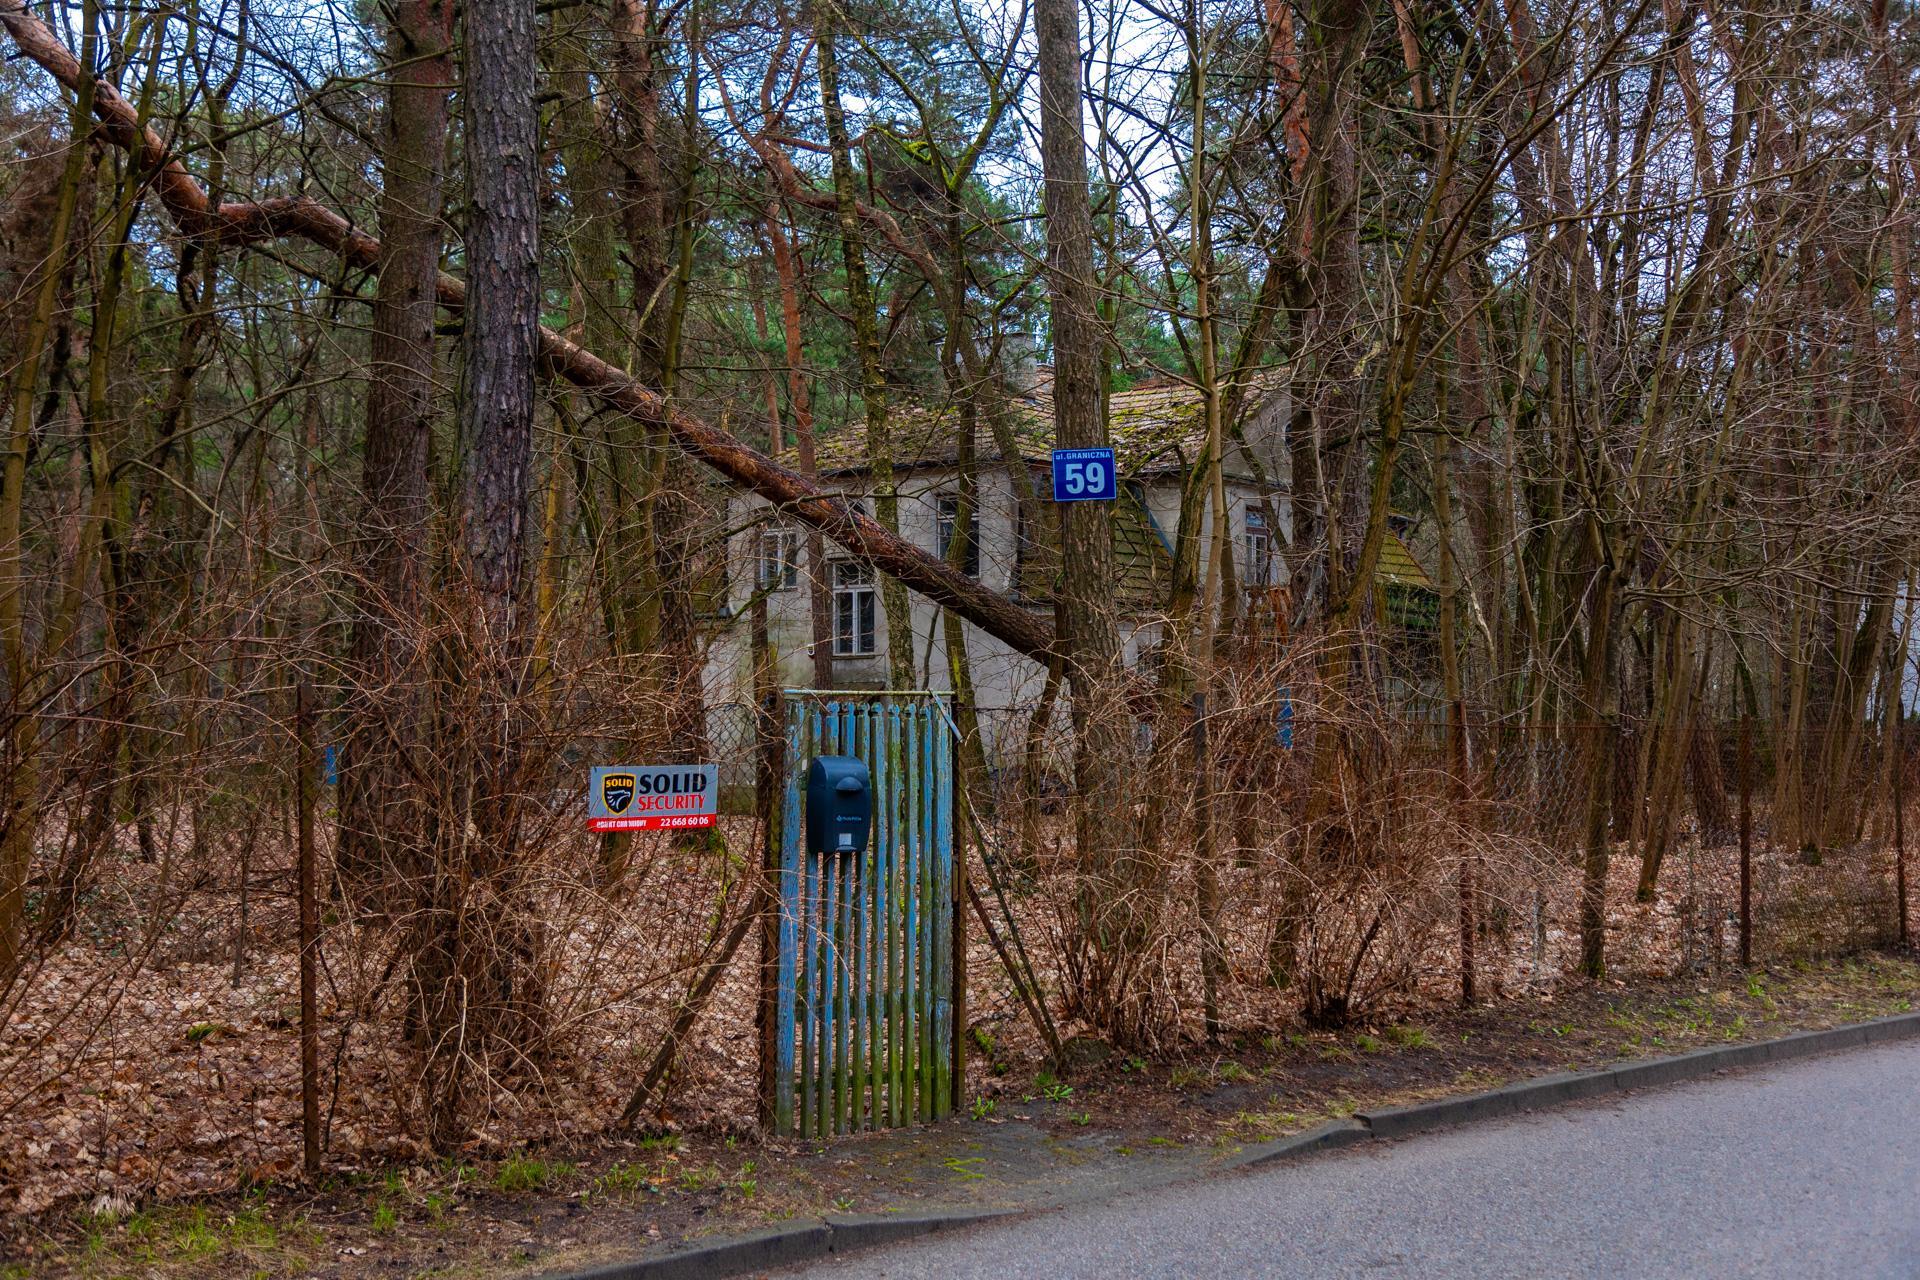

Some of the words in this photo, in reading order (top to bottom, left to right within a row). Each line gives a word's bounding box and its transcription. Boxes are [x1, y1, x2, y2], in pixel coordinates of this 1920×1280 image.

[1065, 462, 1105, 494] 59
[606, 778, 633, 788] SOLID
[639, 773, 707, 795] SOLID
[638, 794, 706, 811] SECURITY
[660, 818, 671, 827] 22
[687, 817, 698, 826] 60
[698, 816, 709, 825] 06
